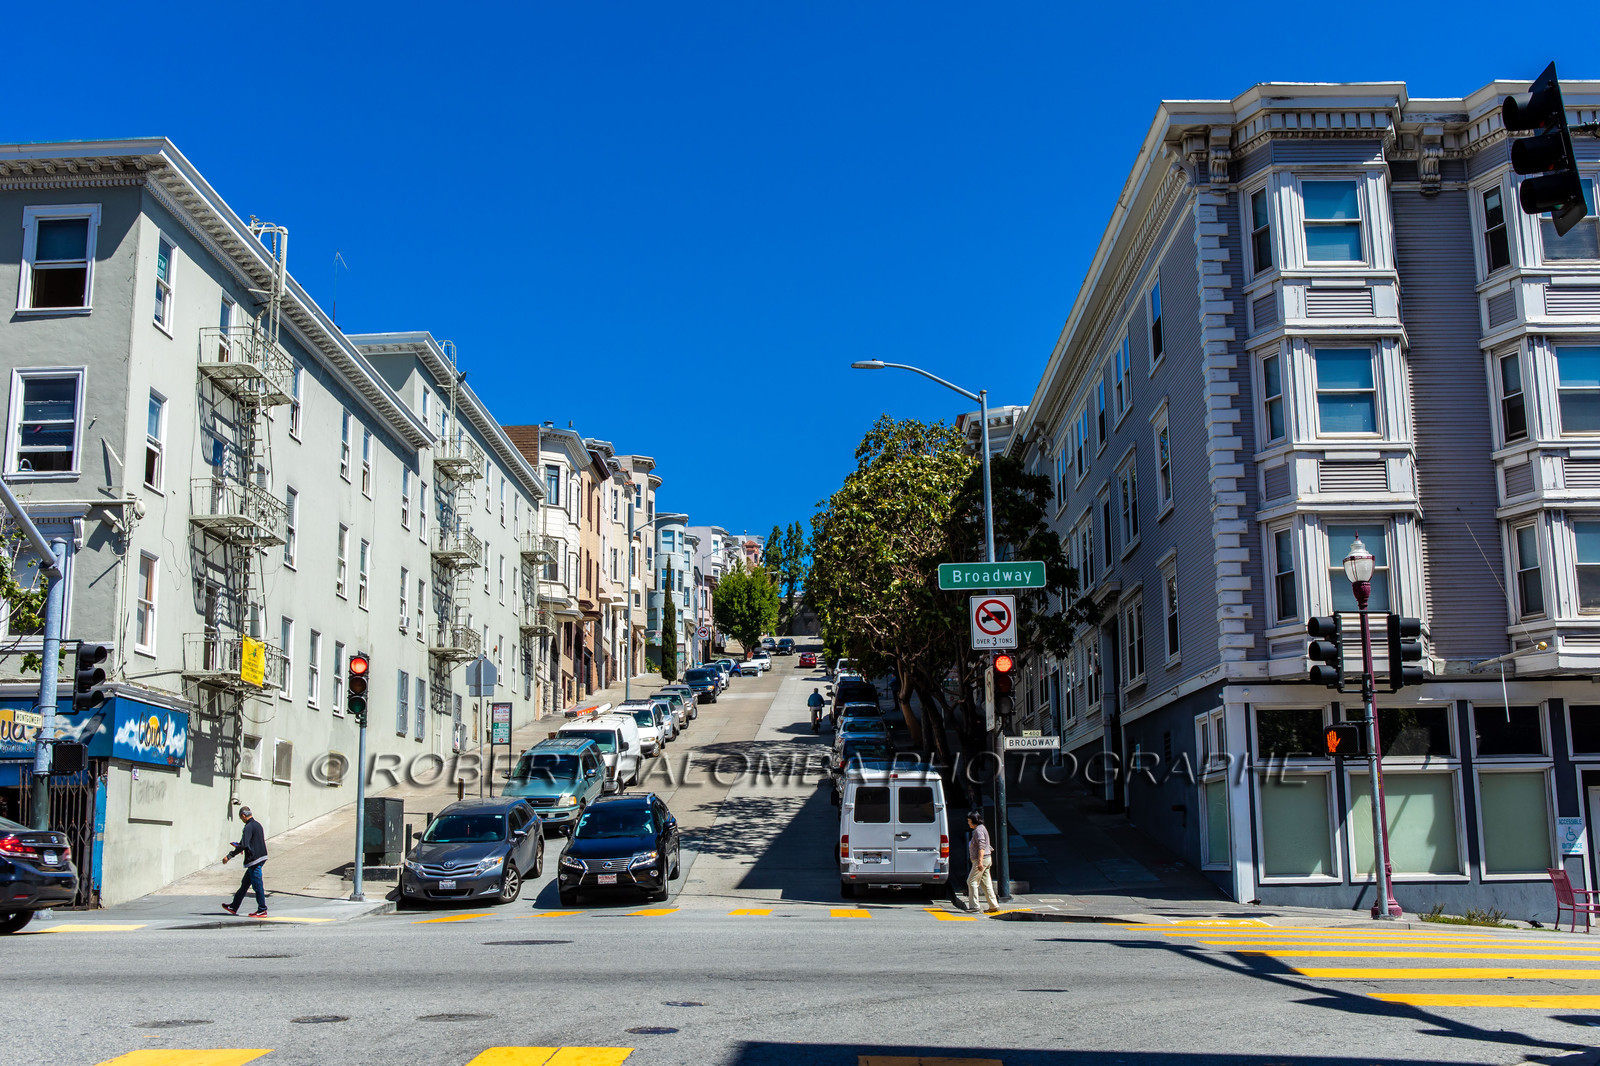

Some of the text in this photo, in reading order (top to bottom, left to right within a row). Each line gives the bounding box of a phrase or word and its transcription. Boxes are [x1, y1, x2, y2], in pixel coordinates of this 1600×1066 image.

[952, 569, 1032, 585] Broadway
[992, 636, 998, 646] 3
[16, 713, 41, 725] MONTGOMERY
[138, 712, 162, 747] Cloud
[1008, 739, 1055, 747] BROADWAY
